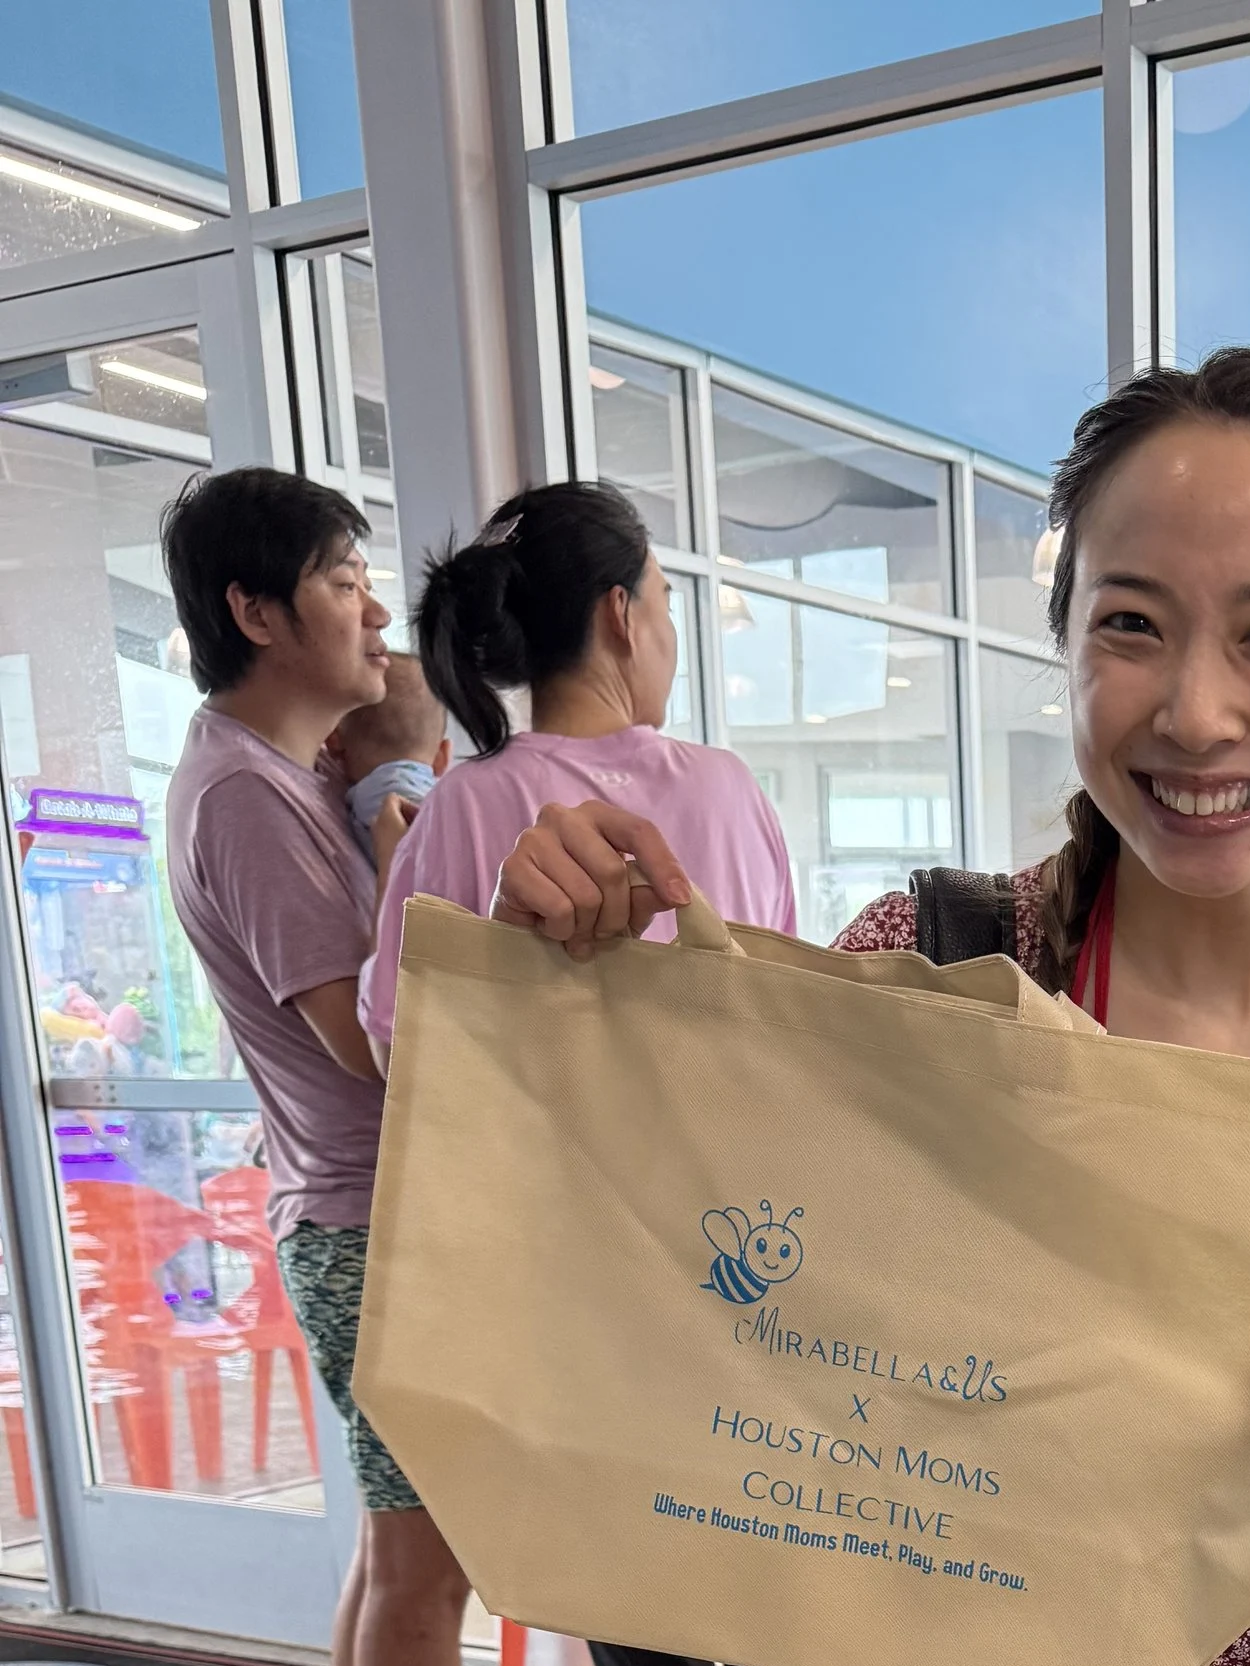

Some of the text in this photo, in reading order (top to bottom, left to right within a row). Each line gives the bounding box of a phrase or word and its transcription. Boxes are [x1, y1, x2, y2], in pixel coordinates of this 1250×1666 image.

[711, 1406, 1002, 1497] HOUSTON MOMS
[653, 1493, 706, 1524] Where
[710, 1508, 780, 1541] Houston
[782, 1524, 838, 1552] Moms
[842, 1532, 893, 1563] Meet,
[943, 1560, 975, 1580] and
[979, 1562, 1029, 1592] Grow.
[742, 1471, 955, 1541] COLLECTIVE
